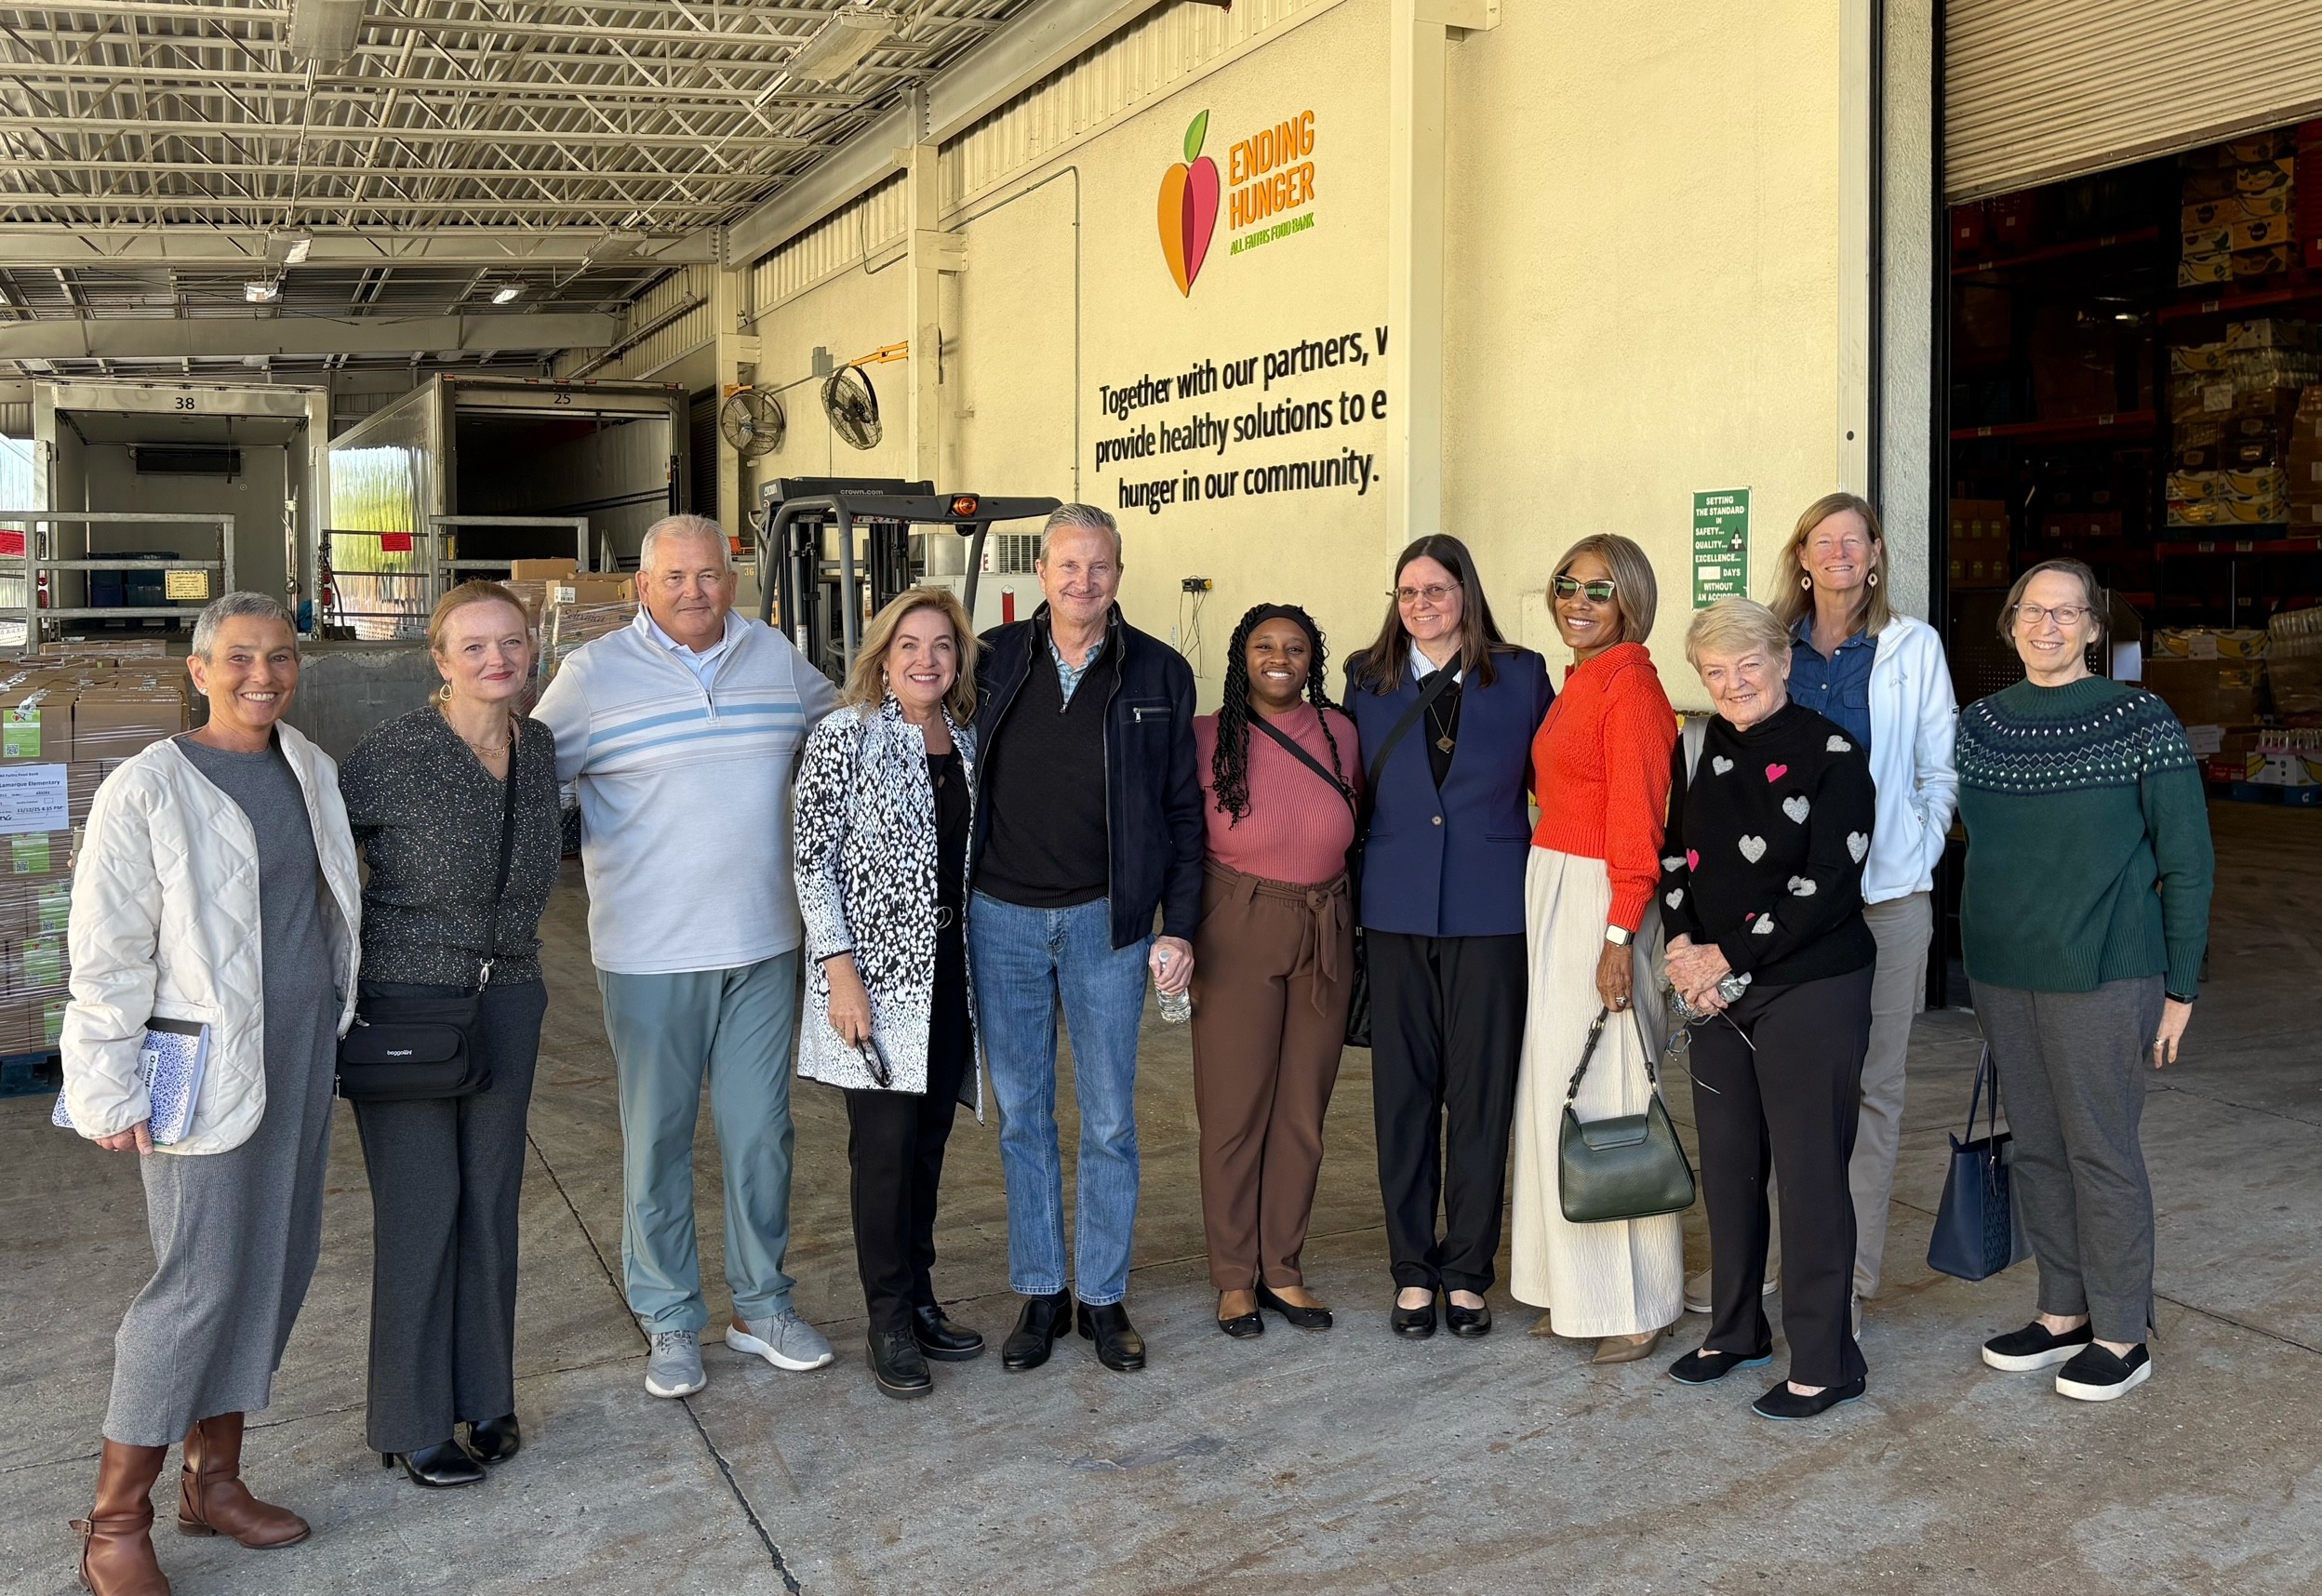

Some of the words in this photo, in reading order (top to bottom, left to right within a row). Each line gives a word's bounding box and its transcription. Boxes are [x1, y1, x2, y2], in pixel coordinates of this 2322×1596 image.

[1229, 110, 1314, 186] ENDING
[1229, 161, 1314, 231] HUNGER
[1230, 238, 1245, 256] ALL
[1245, 228, 1270, 250] FAITHS
[1271, 220, 1291, 241] FOOD
[1291, 212, 1314, 233] BANK
[1100, 374, 1173, 420] Together
[1177, 359, 1218, 400] with
[1222, 355, 1259, 390] our
[1263, 332, 1369, 392] partners,
[175, 397, 195, 410] 38
[554, 392, 571, 405] 25
[1096, 424, 1156, 472] provide
[1160, 414, 1230, 456] healthy
[1234, 397, 1334, 443] solutions
[1339, 391, 1365, 425] to
[1118, 478, 1179, 515] hunger
[1182, 470, 1200, 503] in
[1205, 470, 1240, 499] our
[1243, 446, 1380, 497] community.
[1706, 496, 1734, 505] SETTING
[1696, 508, 1708, 516] THE
[1710, 506, 1744, 515] STANDARD
[1695, 527, 1725, 536] SAFETY...
[1695, 540, 1728, 550] QUALITY...
[1695, 553, 1742, 563] EXCELLENCE...
[1723, 568, 1741, 577] DAYS
[1703, 582, 1733, 591] WITHOUT
[1708, 592, 1741, 601] ACCID
[145, 1055, 155, 1087] Oxford
